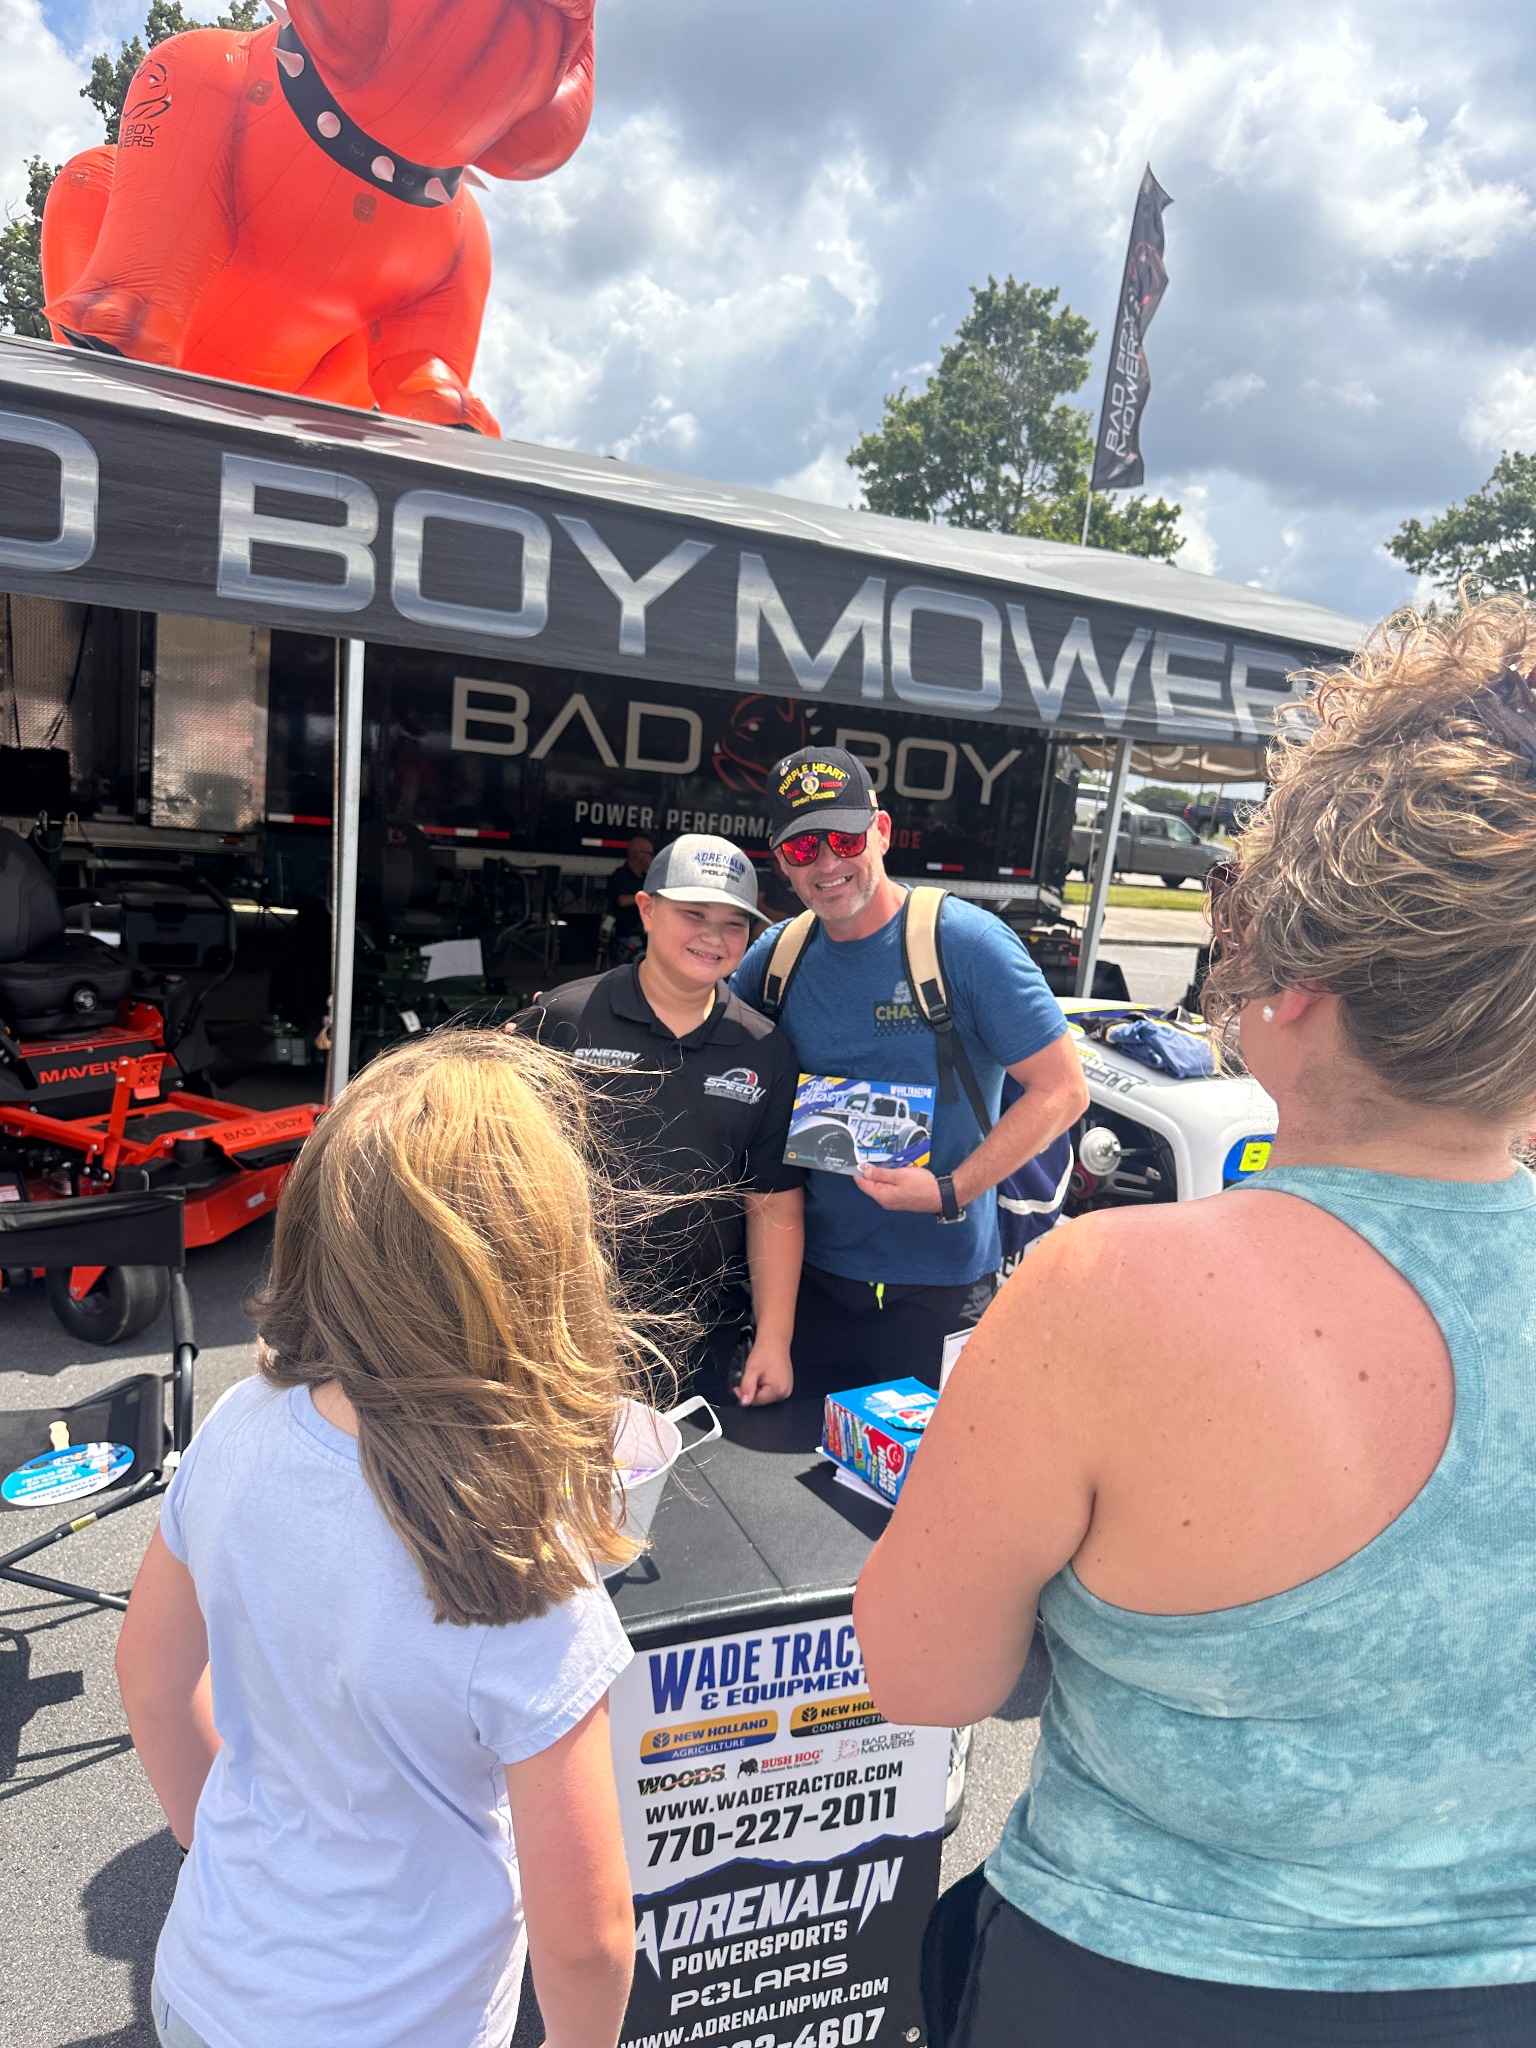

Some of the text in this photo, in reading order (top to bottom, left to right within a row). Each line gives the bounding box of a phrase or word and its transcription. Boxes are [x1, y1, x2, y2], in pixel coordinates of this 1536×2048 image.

[126, 124, 160, 135] BOY
[216, 451, 717, 658] BOY
[451, 676, 1023, 805] BAD BOY
[779, 763, 846, 795] PURPLE HEART
[575, 801, 660, 830] POWER.
[574, 1048, 641, 1061] SYNERGY
[224, 1117, 304, 1141] BAD BOY
[649, 1625, 864, 1714] WADE TRAC
[701, 1692, 720, 1711] &
[821, 1705, 849, 1718] NEW
[674, 1719, 768, 1743] NEW HOLLAND
[863, 1730, 915, 1747] BAD BOY
[671, 1738, 746, 1758] AGRICULTURE
[761, 1754, 792, 1769] BUSH
[860, 1739, 914, 1755] MOWERS
[637, 1763, 726, 1796] WOODS
[646, 1760, 903, 1825] WWW.WADETRACTOR.COM
[647, 1786, 897, 1868] 770-227-2011
[635, 1856, 904, 1982] ADRENALIN
[671, 1919, 849, 1980] POWERSPORTS
[670, 1953, 849, 2016] POLARIS
